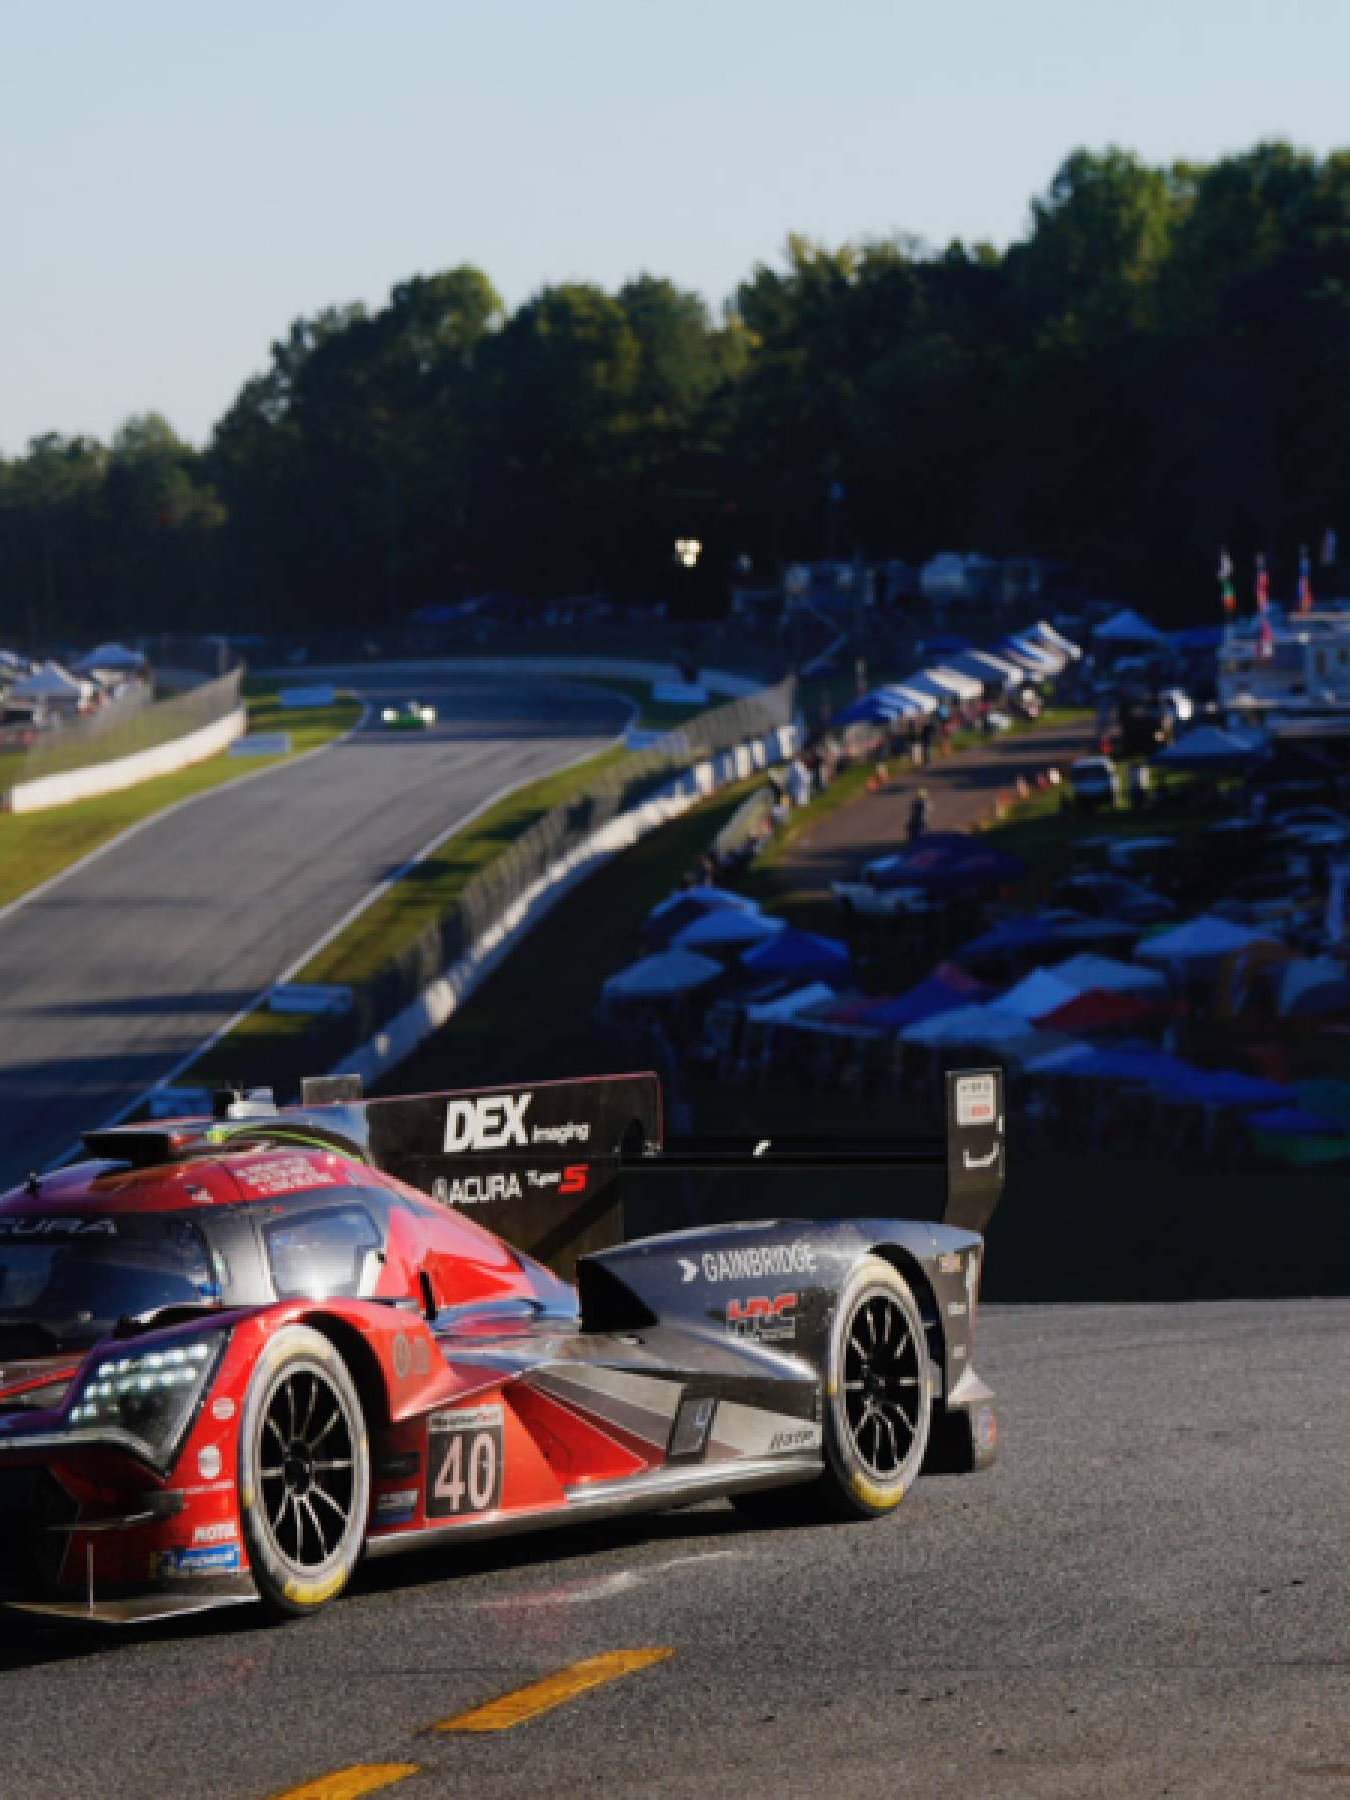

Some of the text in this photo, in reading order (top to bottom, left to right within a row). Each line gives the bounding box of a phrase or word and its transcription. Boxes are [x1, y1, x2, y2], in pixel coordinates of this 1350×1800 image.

[443, 1092, 532, 1153] DEX
[449, 1173, 523, 1203] ACURA
[557, 1163, 590, 1194] S
[701, 1243, 817, 1281] GAINBRIDGE
[433, 1433, 495, 1512] 40
